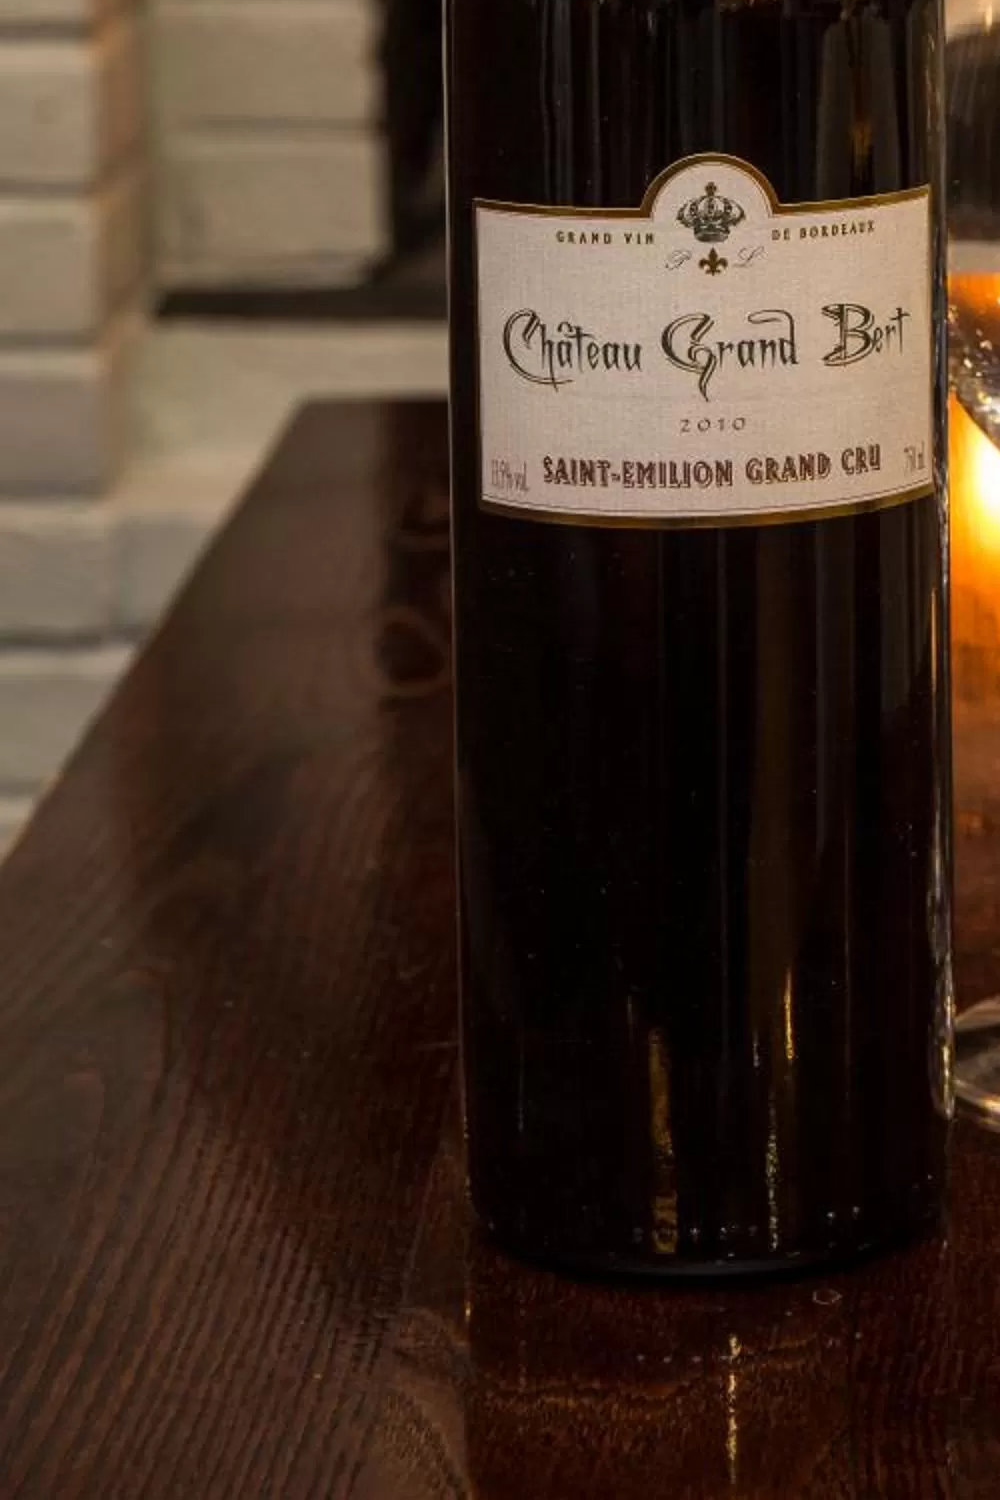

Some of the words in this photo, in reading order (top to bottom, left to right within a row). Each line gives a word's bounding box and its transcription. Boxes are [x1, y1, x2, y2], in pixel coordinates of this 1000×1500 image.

[555, 230, 612, 244] GRAND
[624, 232, 655, 244] VIN
[771, 228, 791, 241] DE
[799, 219, 875, 239] BORDEAUX
[503, 308, 642, 392] Château
[661, 308, 799, 402] Grand
[821, 303, 911, 367] Bert
[680, 417, 746, 433] 2010
[543, 455, 733, 489] SAINT-EMILION
[745, 452, 831, 485] GRAND
[841, 443, 881, 475] CRU
